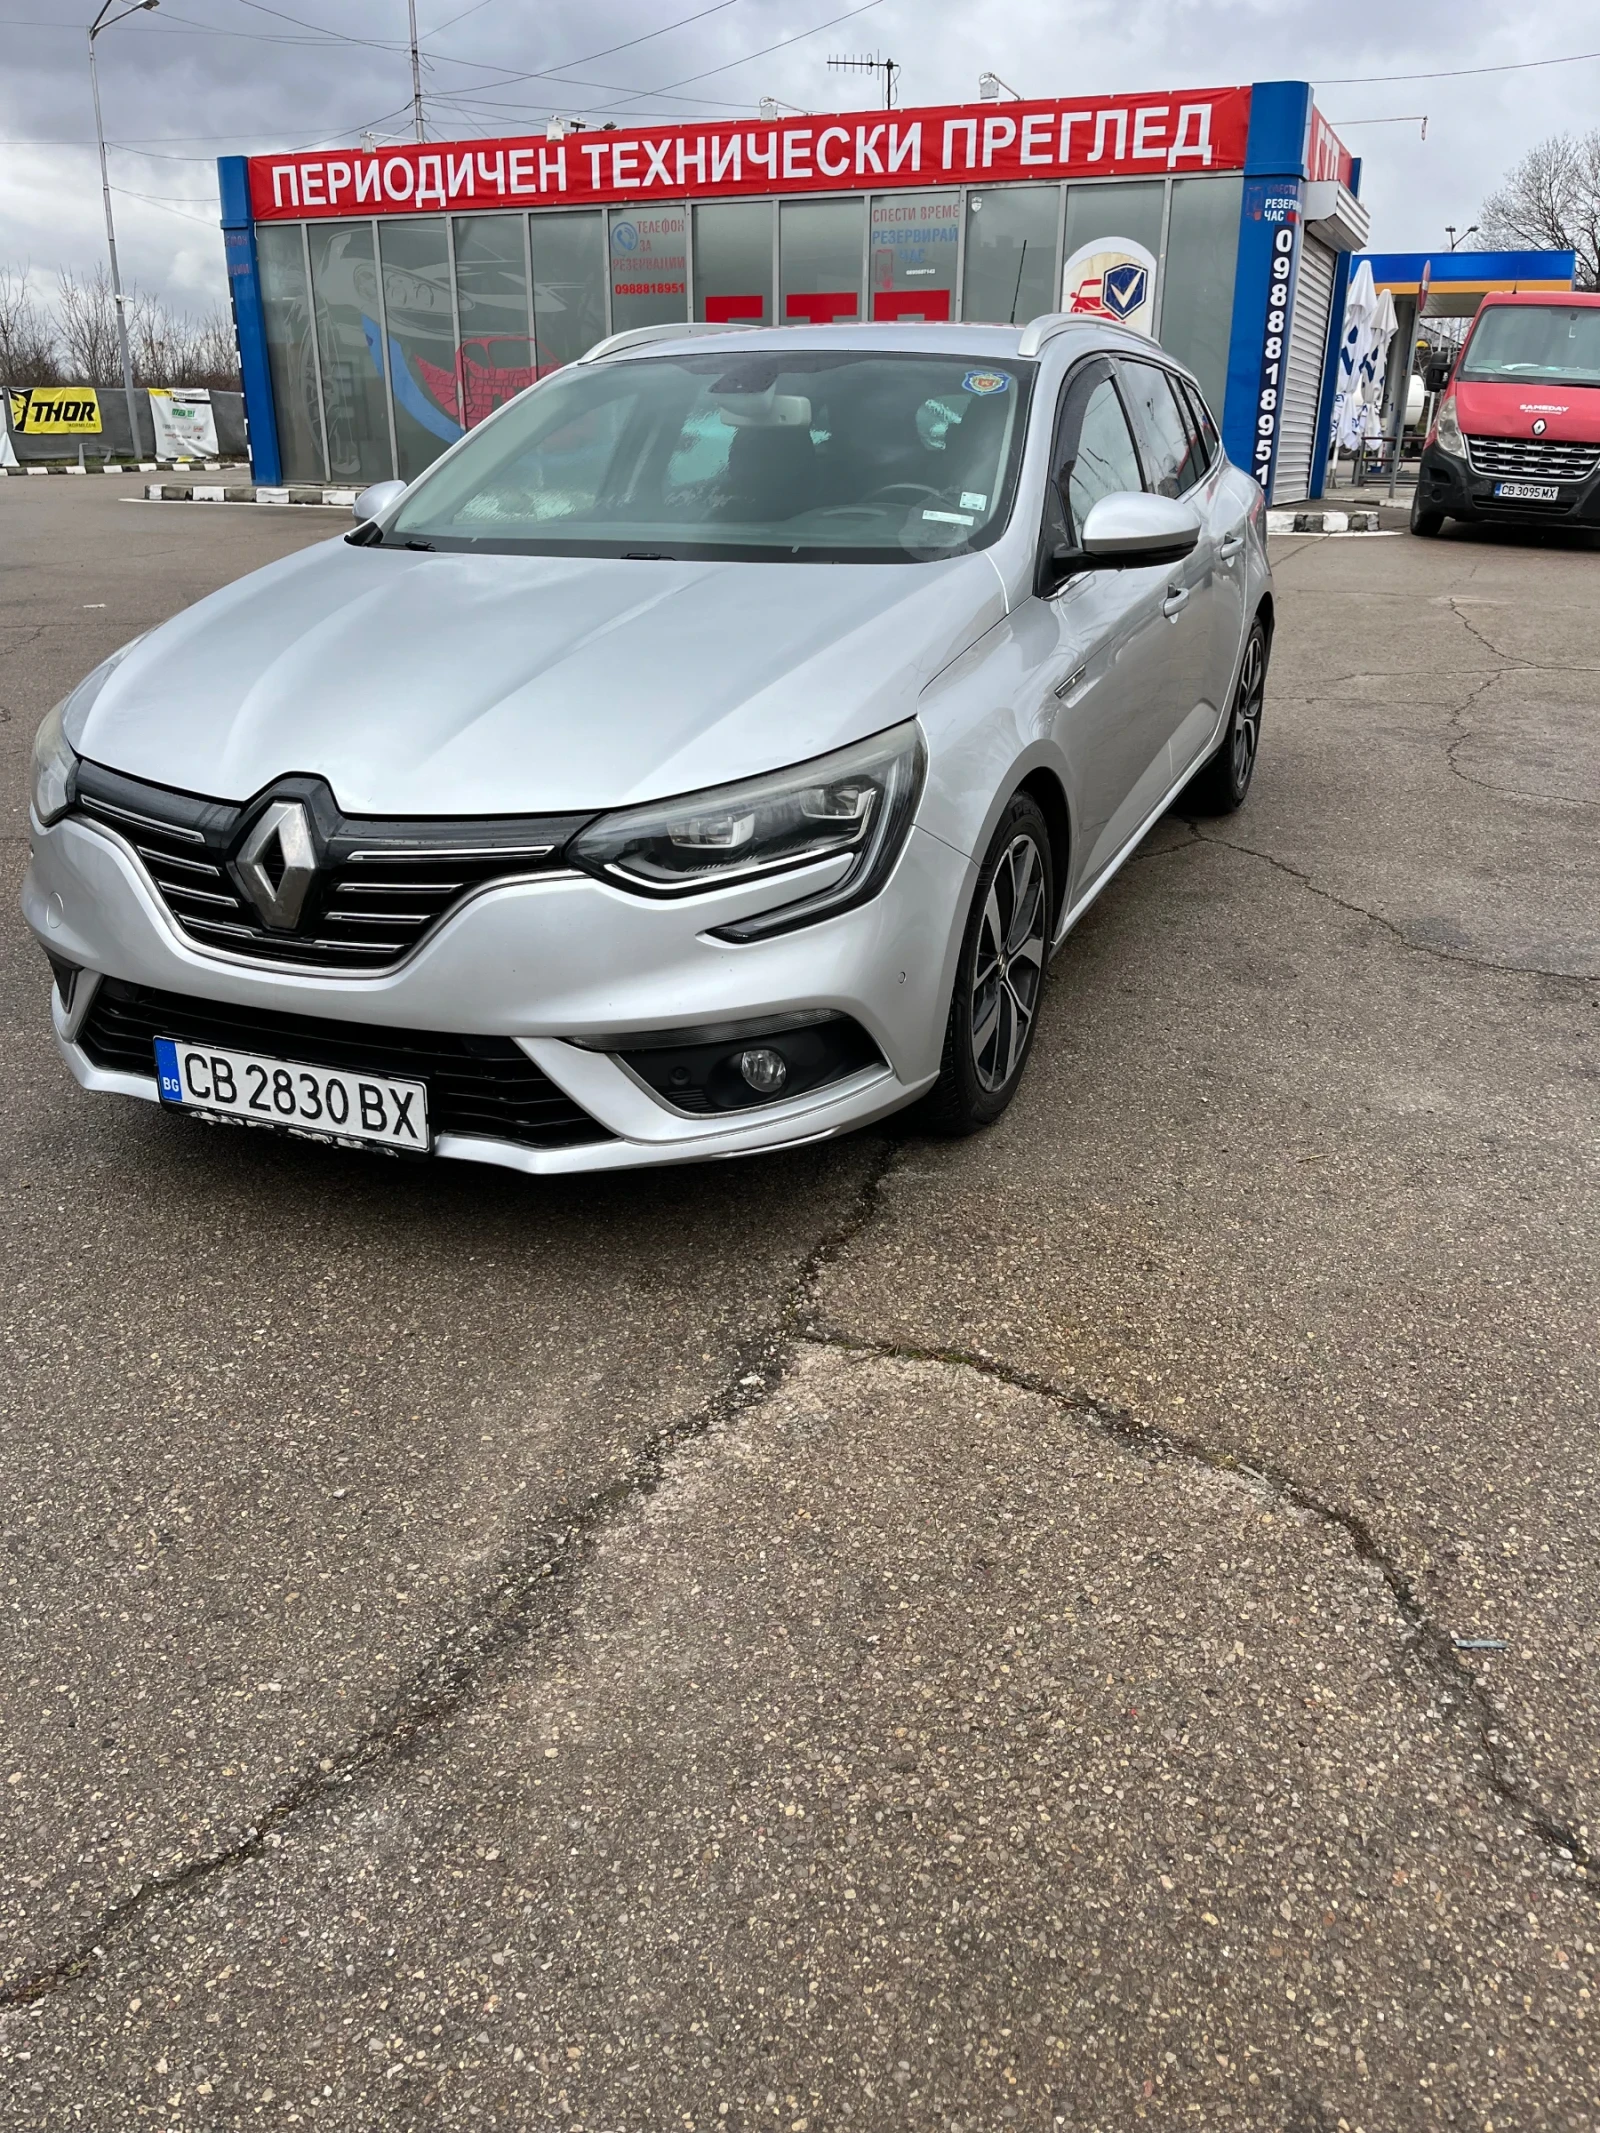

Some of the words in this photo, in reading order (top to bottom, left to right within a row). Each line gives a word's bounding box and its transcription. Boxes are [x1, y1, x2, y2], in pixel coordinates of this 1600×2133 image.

[271, 146, 566, 209] ПЕРИОДИЧЕН
[581, 121, 923, 191] ТЕХНИЧЕСКИ
[942, 103, 1213, 170] ПРЕГЛЕД
[873, 207, 916, 223] СПЕСТИ
[920, 203, 960, 220] ВРЕМЕ
[1264, 210, 1285, 222] ЧАС
[637, 219, 684, 234] ТЕЛЕФОН
[872, 224, 958, 245] РЕЗЕРВИРАЙ
[640, 240, 652, 252] ЗА
[899, 248, 925, 264] ЧАС
[613, 257, 685, 271] РЕЗЕРВАЦИИ
[615, 283, 684, 294] 0988818951
[1256, 229, 1293, 486] 0988818951
[32, 401, 95, 422] THOR
[1520, 404, 1569, 412] SAMEDAY
[1502, 485, 1515, 495] CB
[1516, 487, 1540, 497] 3095
[1541, 490, 1556, 498] MX
[163, 1078, 179, 1092] BG
[185, 1053, 237, 1104] CB
[246, 1064, 349, 1124] 2830
[358, 1083, 418, 1139] BX
